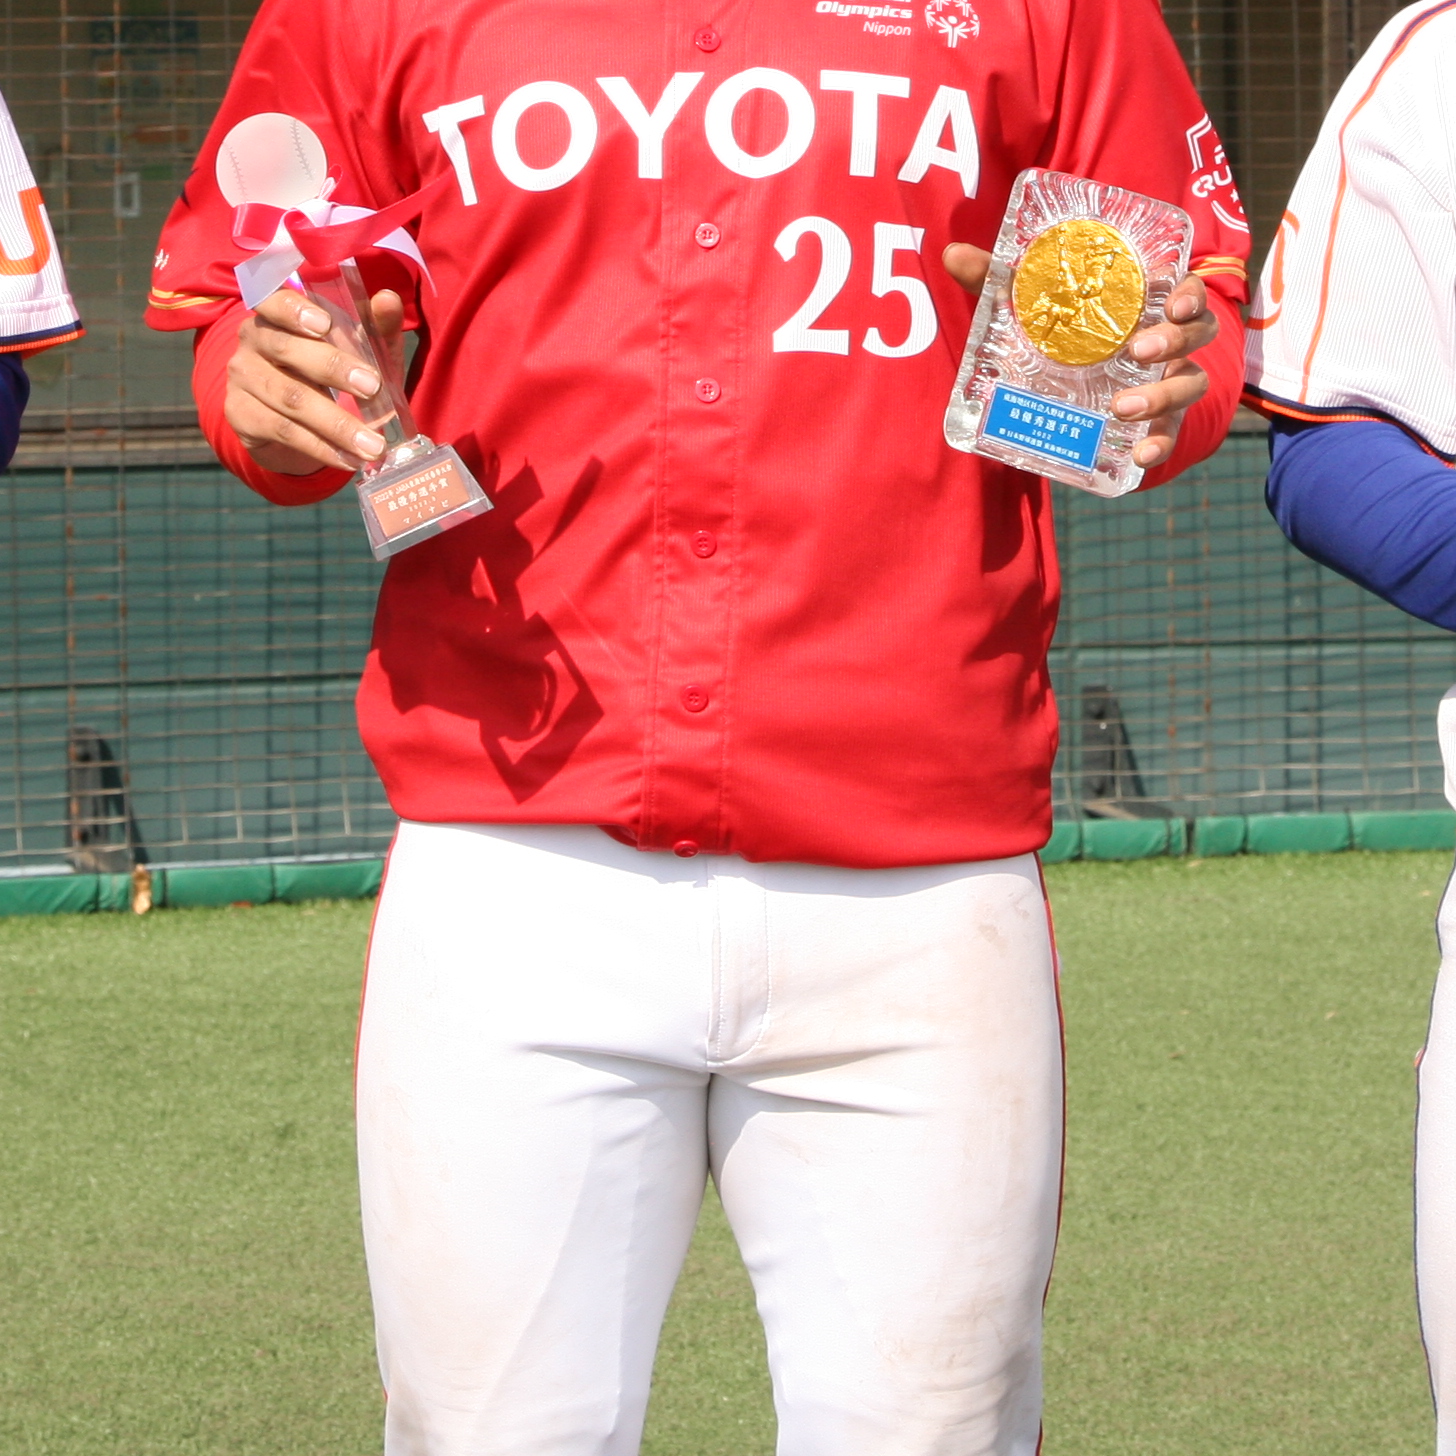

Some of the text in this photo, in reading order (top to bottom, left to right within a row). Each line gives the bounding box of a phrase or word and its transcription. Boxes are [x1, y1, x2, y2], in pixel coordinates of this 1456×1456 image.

[815, 0, 913, 19] Olympics
[862, 20, 912, 36] Nippon
[421, 66, 982, 206] TOYOTA
[772, 215, 940, 359] 25
